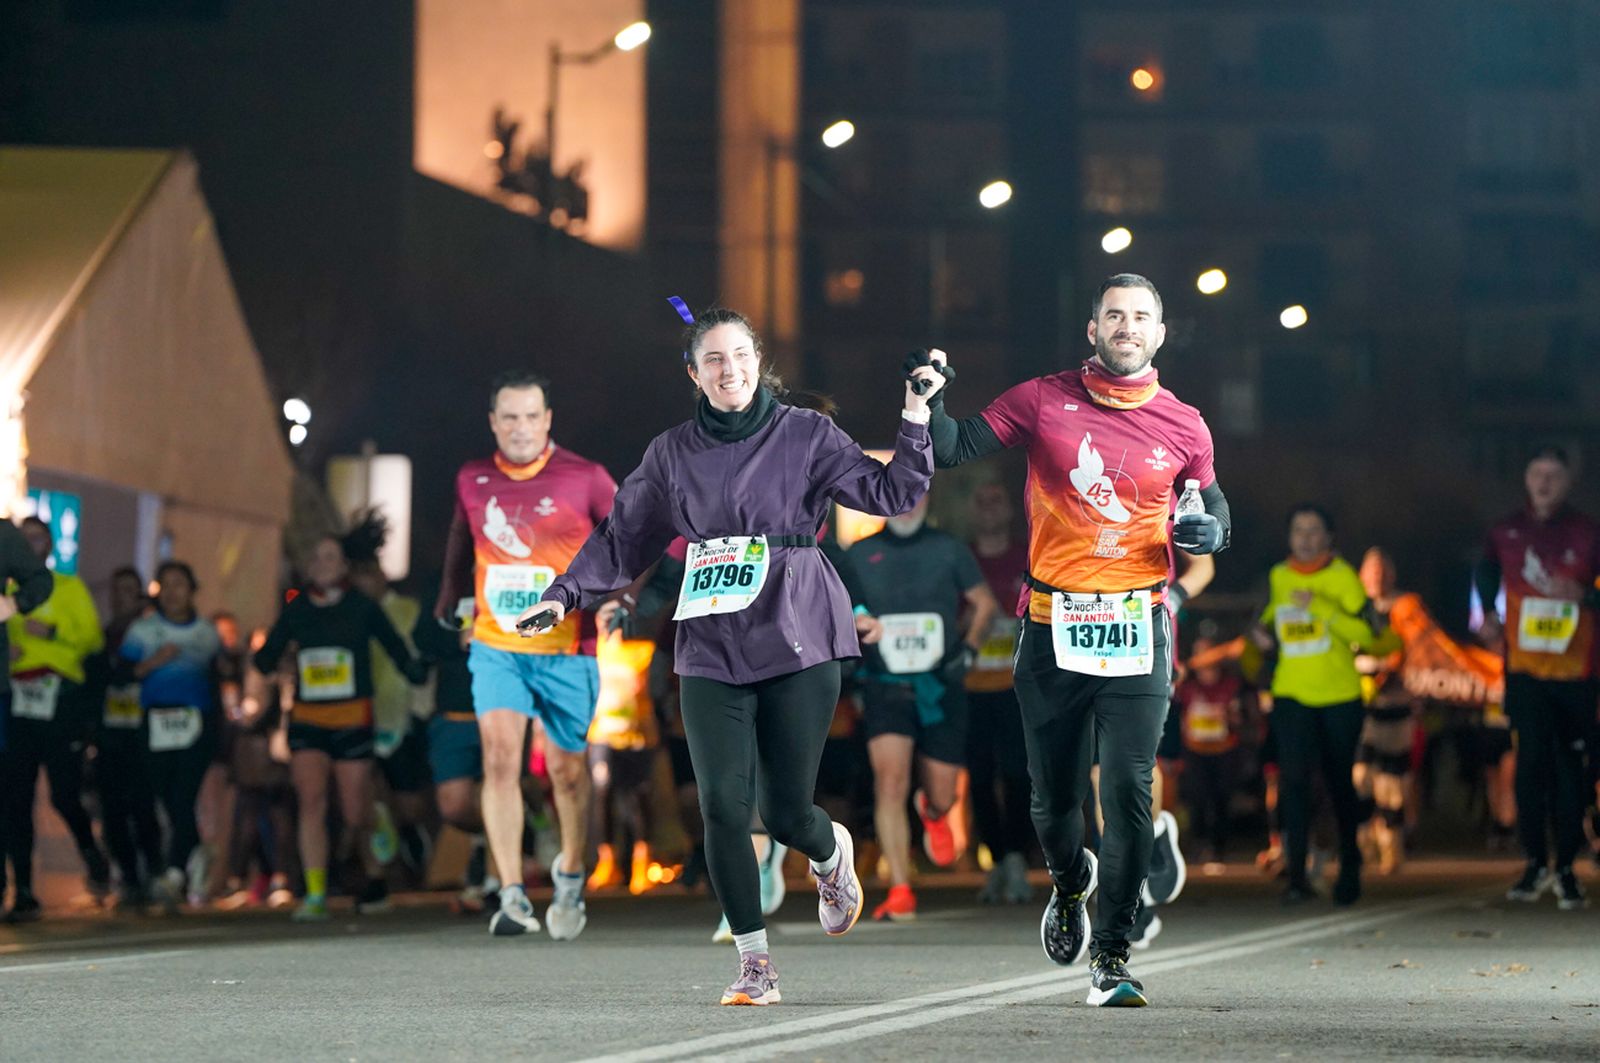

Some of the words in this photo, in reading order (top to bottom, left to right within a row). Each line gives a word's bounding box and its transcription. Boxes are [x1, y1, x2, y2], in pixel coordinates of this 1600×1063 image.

[1087, 482, 1112, 507] 43
[693, 558, 708, 569] SAN
[693, 564, 755, 592] 13796
[1104, 602, 1114, 610] DE
[1063, 613, 1082, 622] SAN
[1066, 623, 1138, 648] 13746
